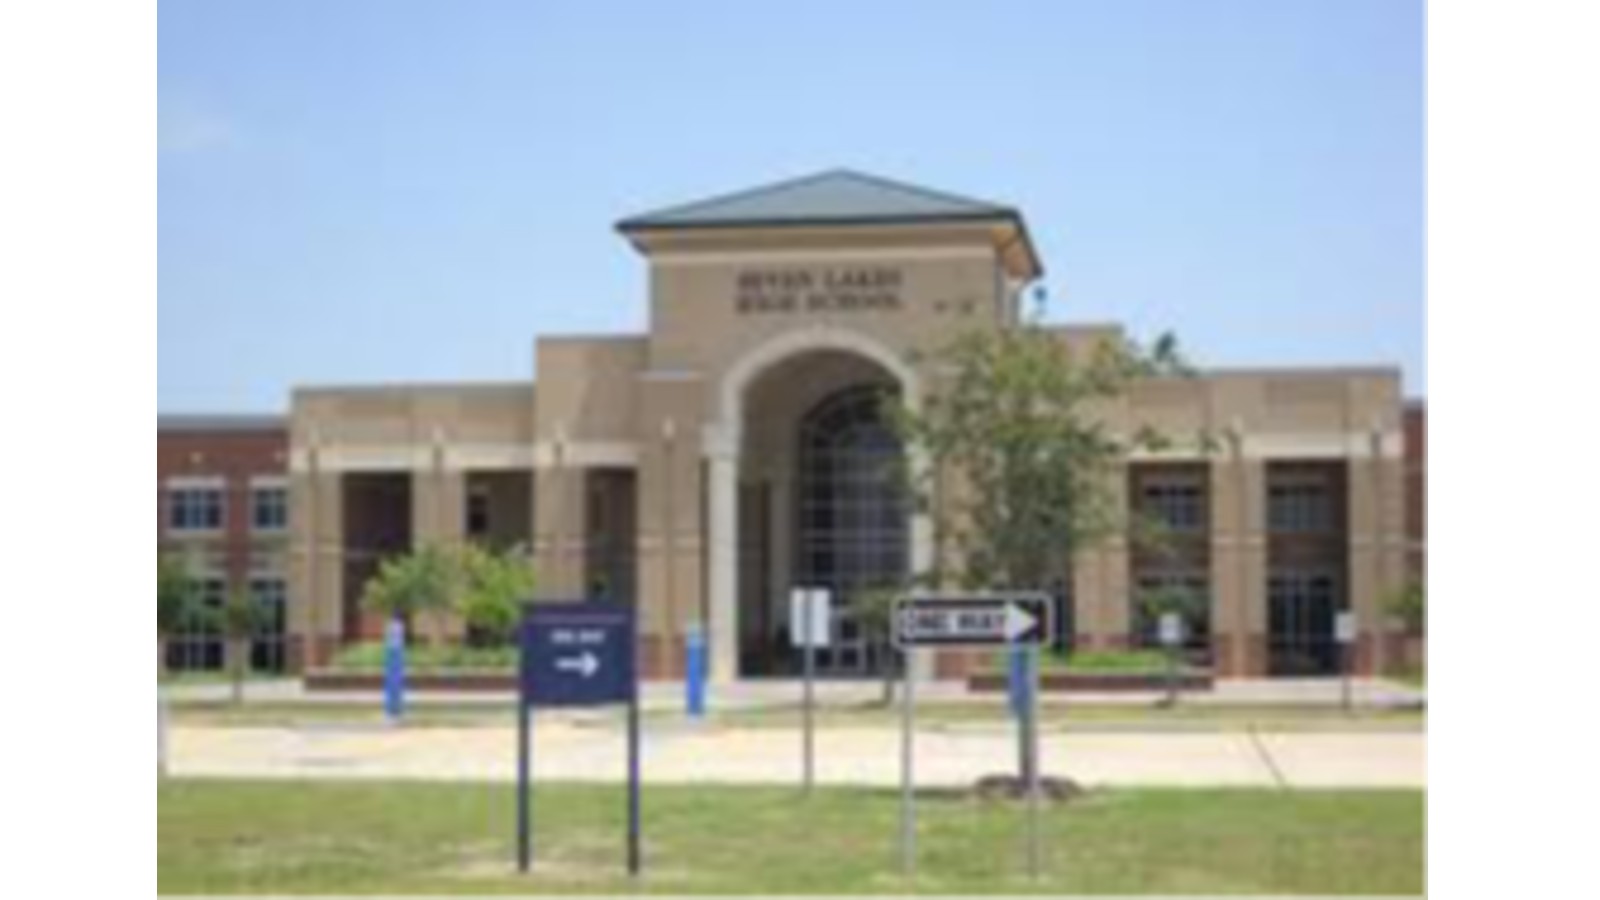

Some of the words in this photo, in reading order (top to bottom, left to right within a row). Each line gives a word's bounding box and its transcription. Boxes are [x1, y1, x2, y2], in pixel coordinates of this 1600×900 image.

[737, 270, 814, 289] SEVEN
[824, 268, 903, 287] LAKES
[736, 294, 796, 313] HIGH
[806, 292, 903, 312] SCHOOL
[903, 609, 948, 634] ONE
[956, 609, 1005, 634] WAY
